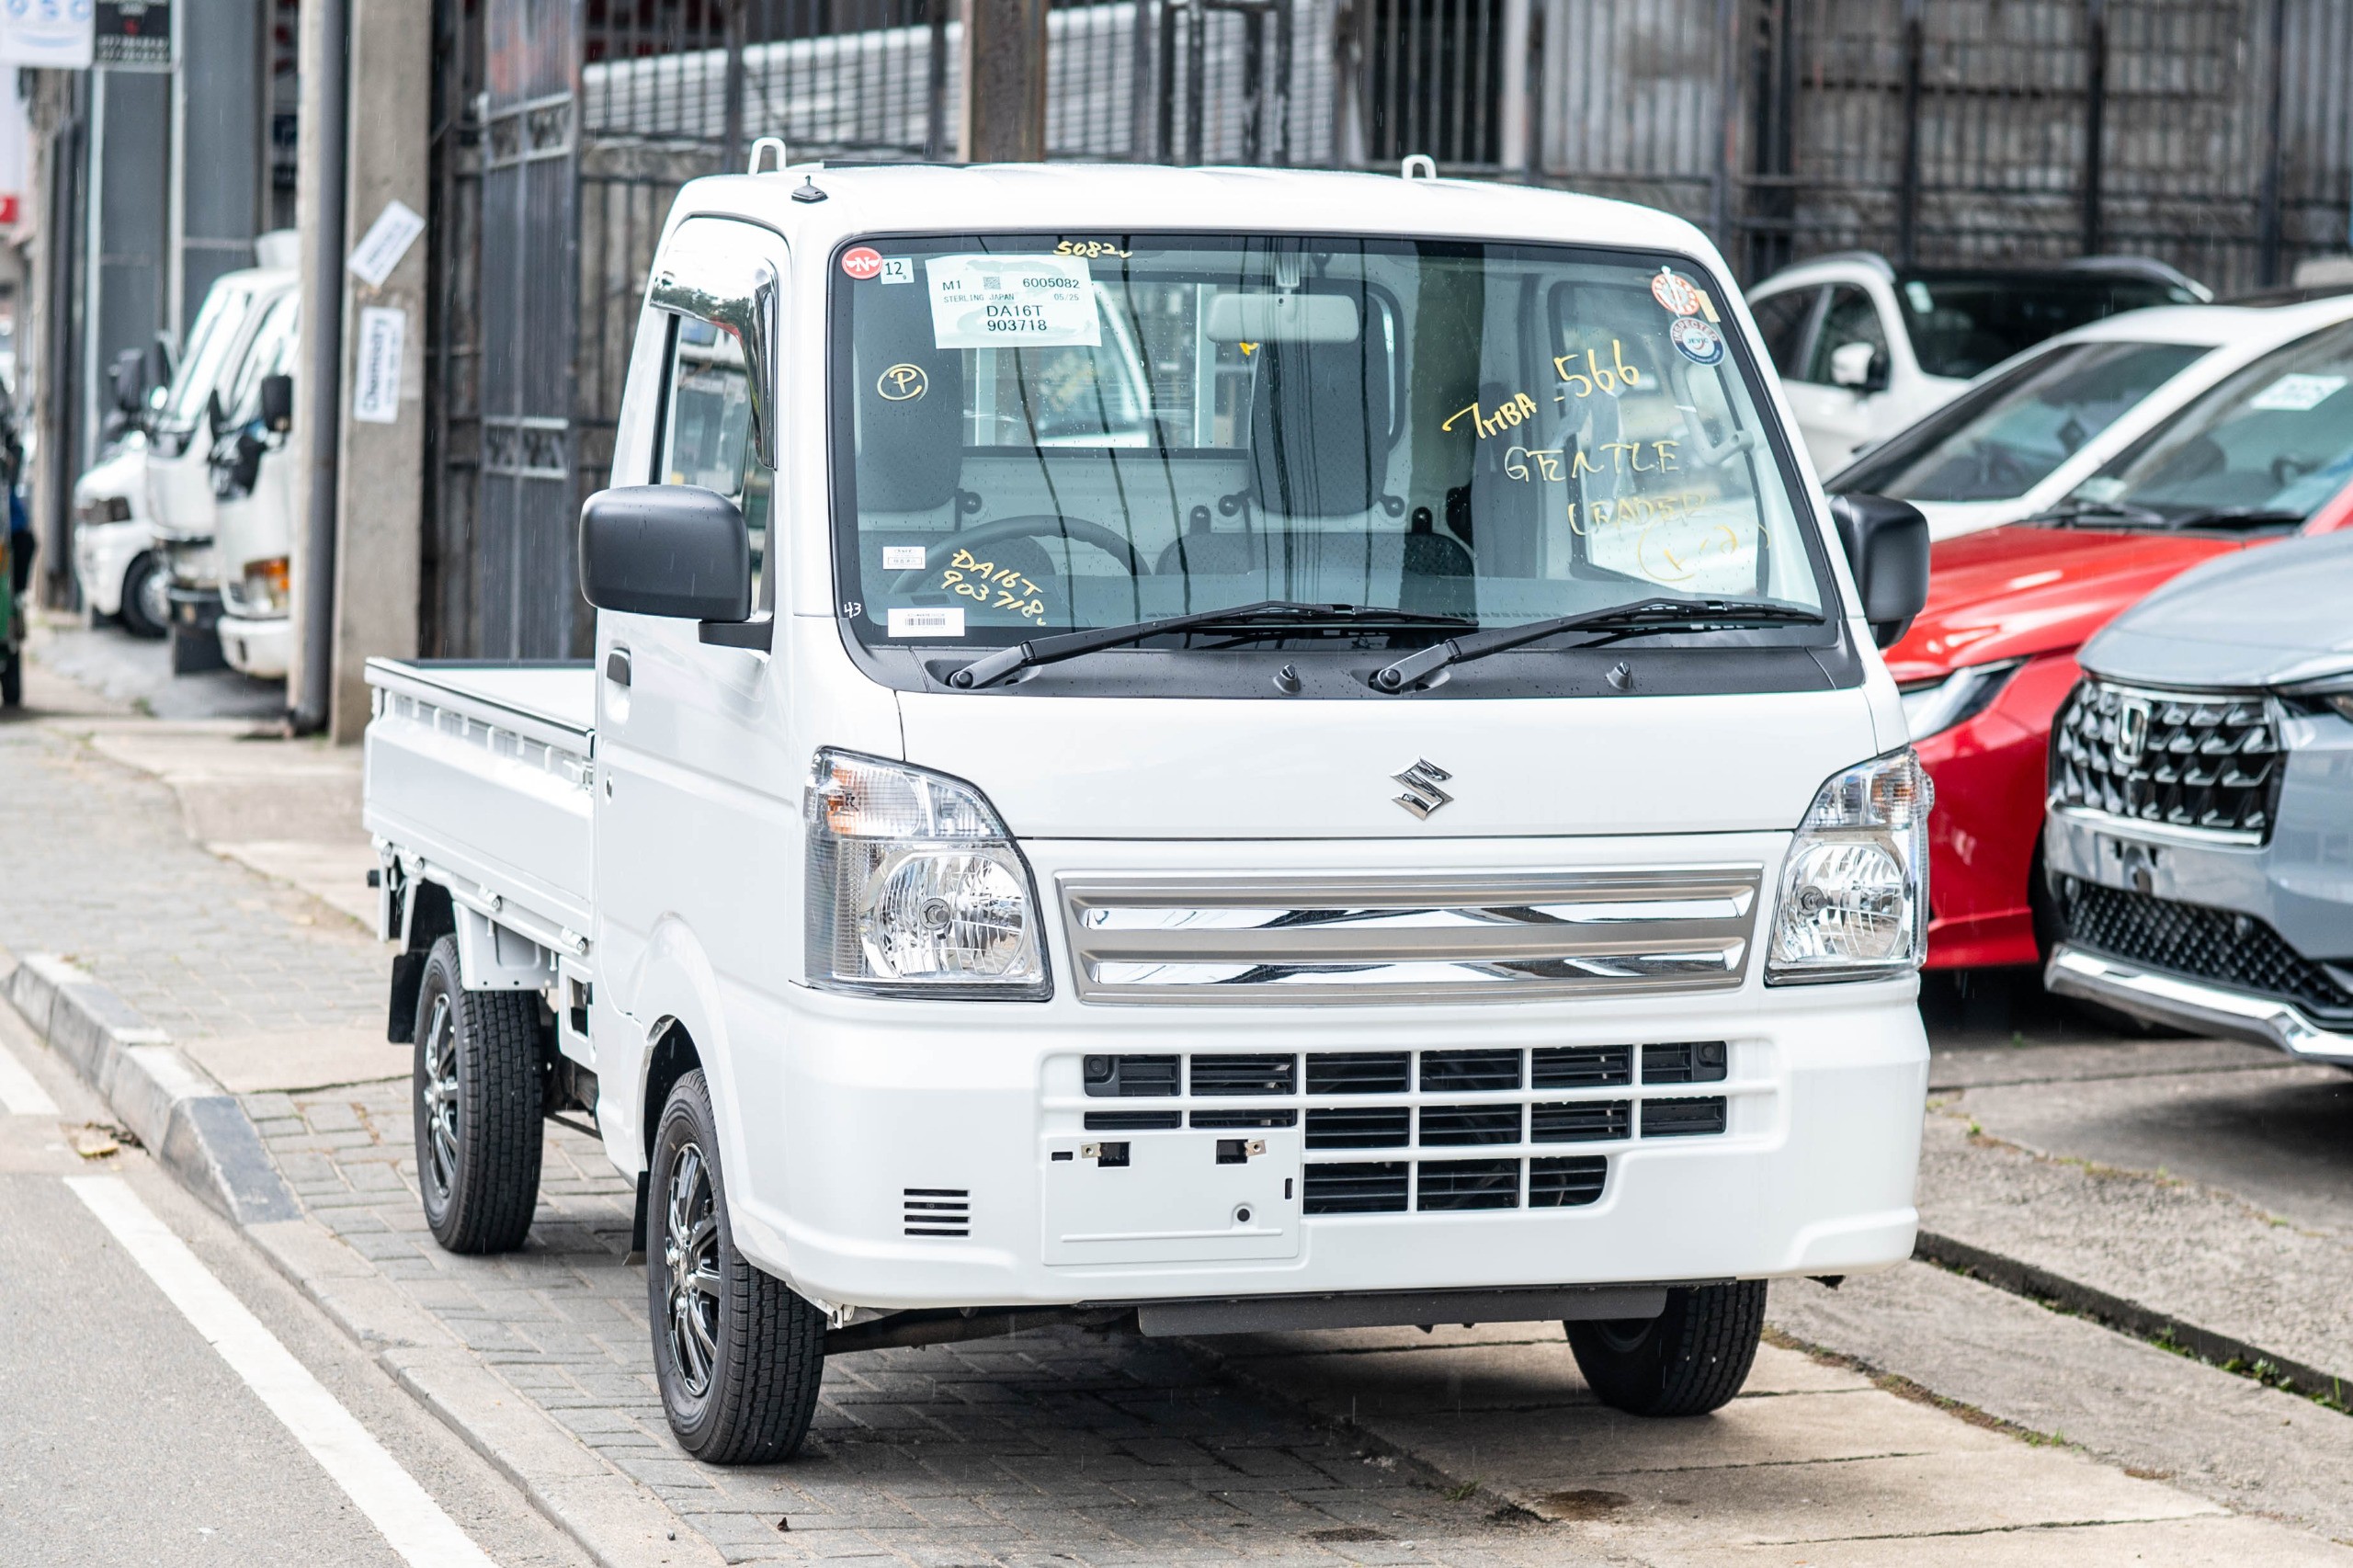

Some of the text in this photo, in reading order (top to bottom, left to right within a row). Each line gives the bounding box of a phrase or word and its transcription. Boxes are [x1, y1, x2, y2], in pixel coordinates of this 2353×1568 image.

[884, 261, 904, 276] 12
[942, 278, 1080, 290] M1 6005082
[943, 292, 1079, 302] STERLING JAPAN 05/25
[986, 304, 1043, 317] DA16T
[987, 319, 1047, 332] 903718
[1674, 319, 1718, 343] INSPECTED
[951, 549, 1043, 597] DA16T
[941, 570, 1045, 618] 903718
[844, 601, 861, 619] 43
